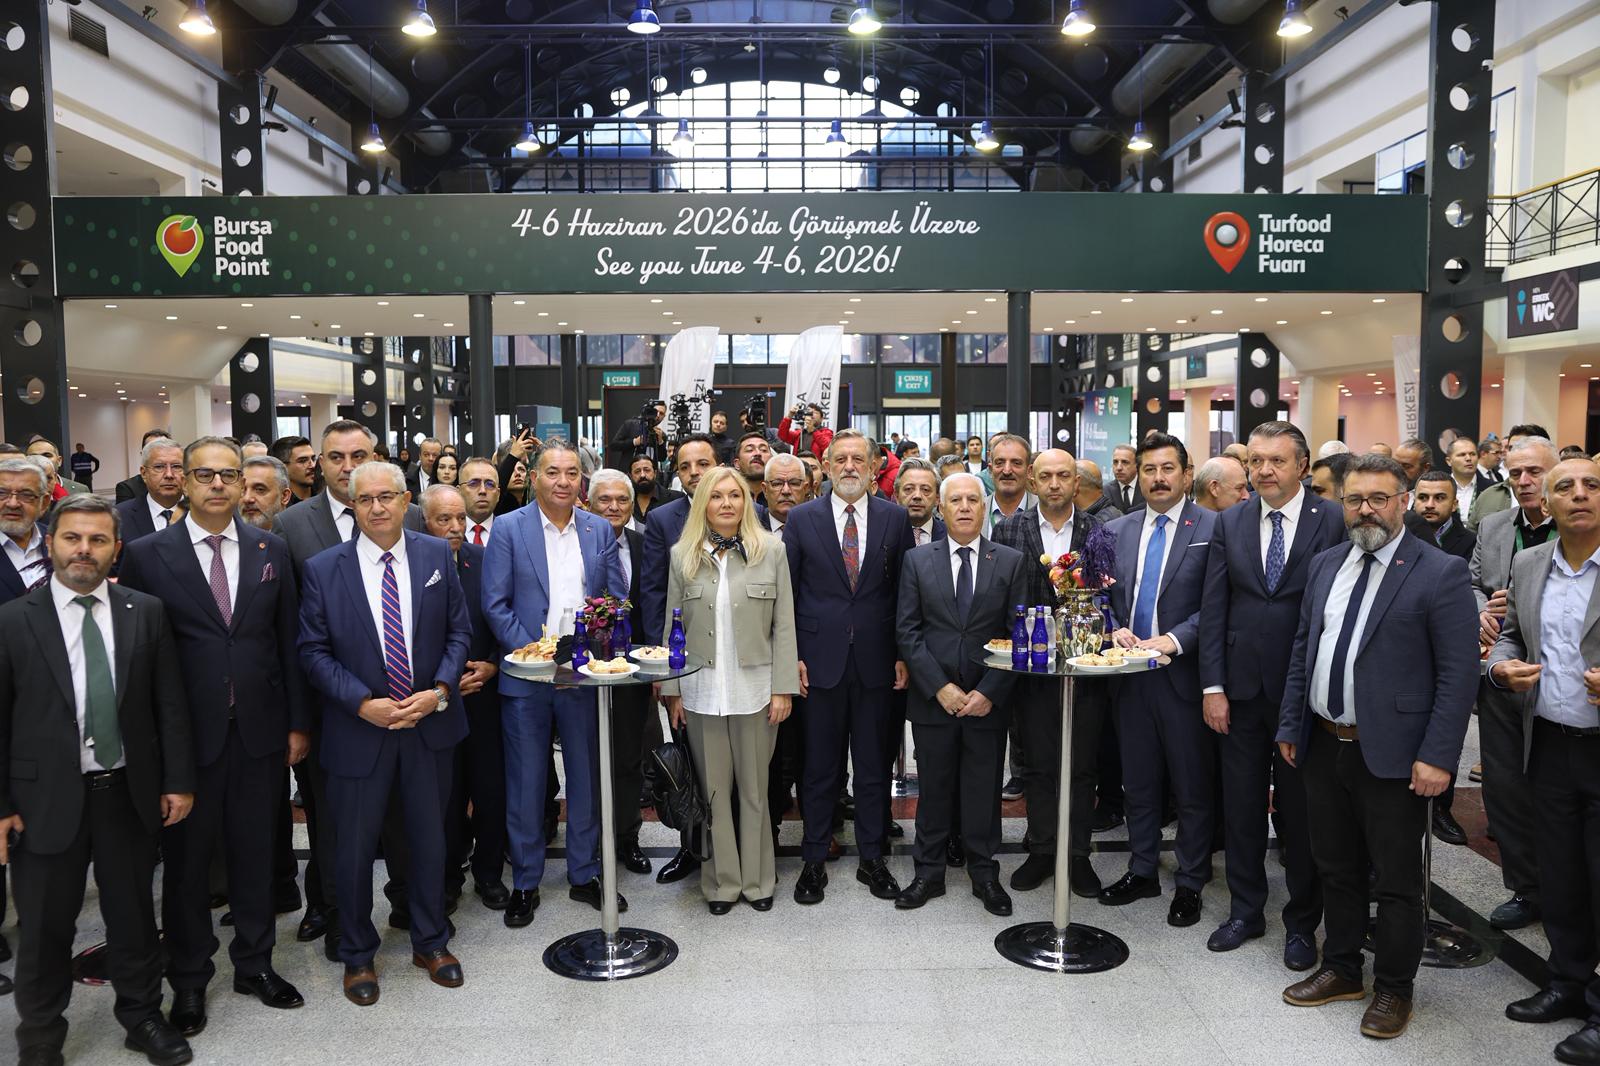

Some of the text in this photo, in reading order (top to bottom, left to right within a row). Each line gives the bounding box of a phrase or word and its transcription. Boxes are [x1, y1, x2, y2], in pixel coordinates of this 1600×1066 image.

[213, 215, 273, 236] Bursa
[511, 207, 560, 237] 4-6
[567, 207, 668, 237] Haziran
[788, 206, 904, 243] Görüşmek
[909, 200, 981, 235] Üzere
[1258, 212, 1332, 234] Turfood
[214, 235, 264, 257] Food
[1258, 234, 1325, 254] Horeca
[214, 255, 270, 276] Point
[594, 246, 635, 276] See
[639, 260, 685, 285] you
[690, 245, 746, 276] June
[814, 244, 902, 274] 2026!
[1258, 253, 1308, 274] Fuarı
[1532, 301, 1555, 323] WC
